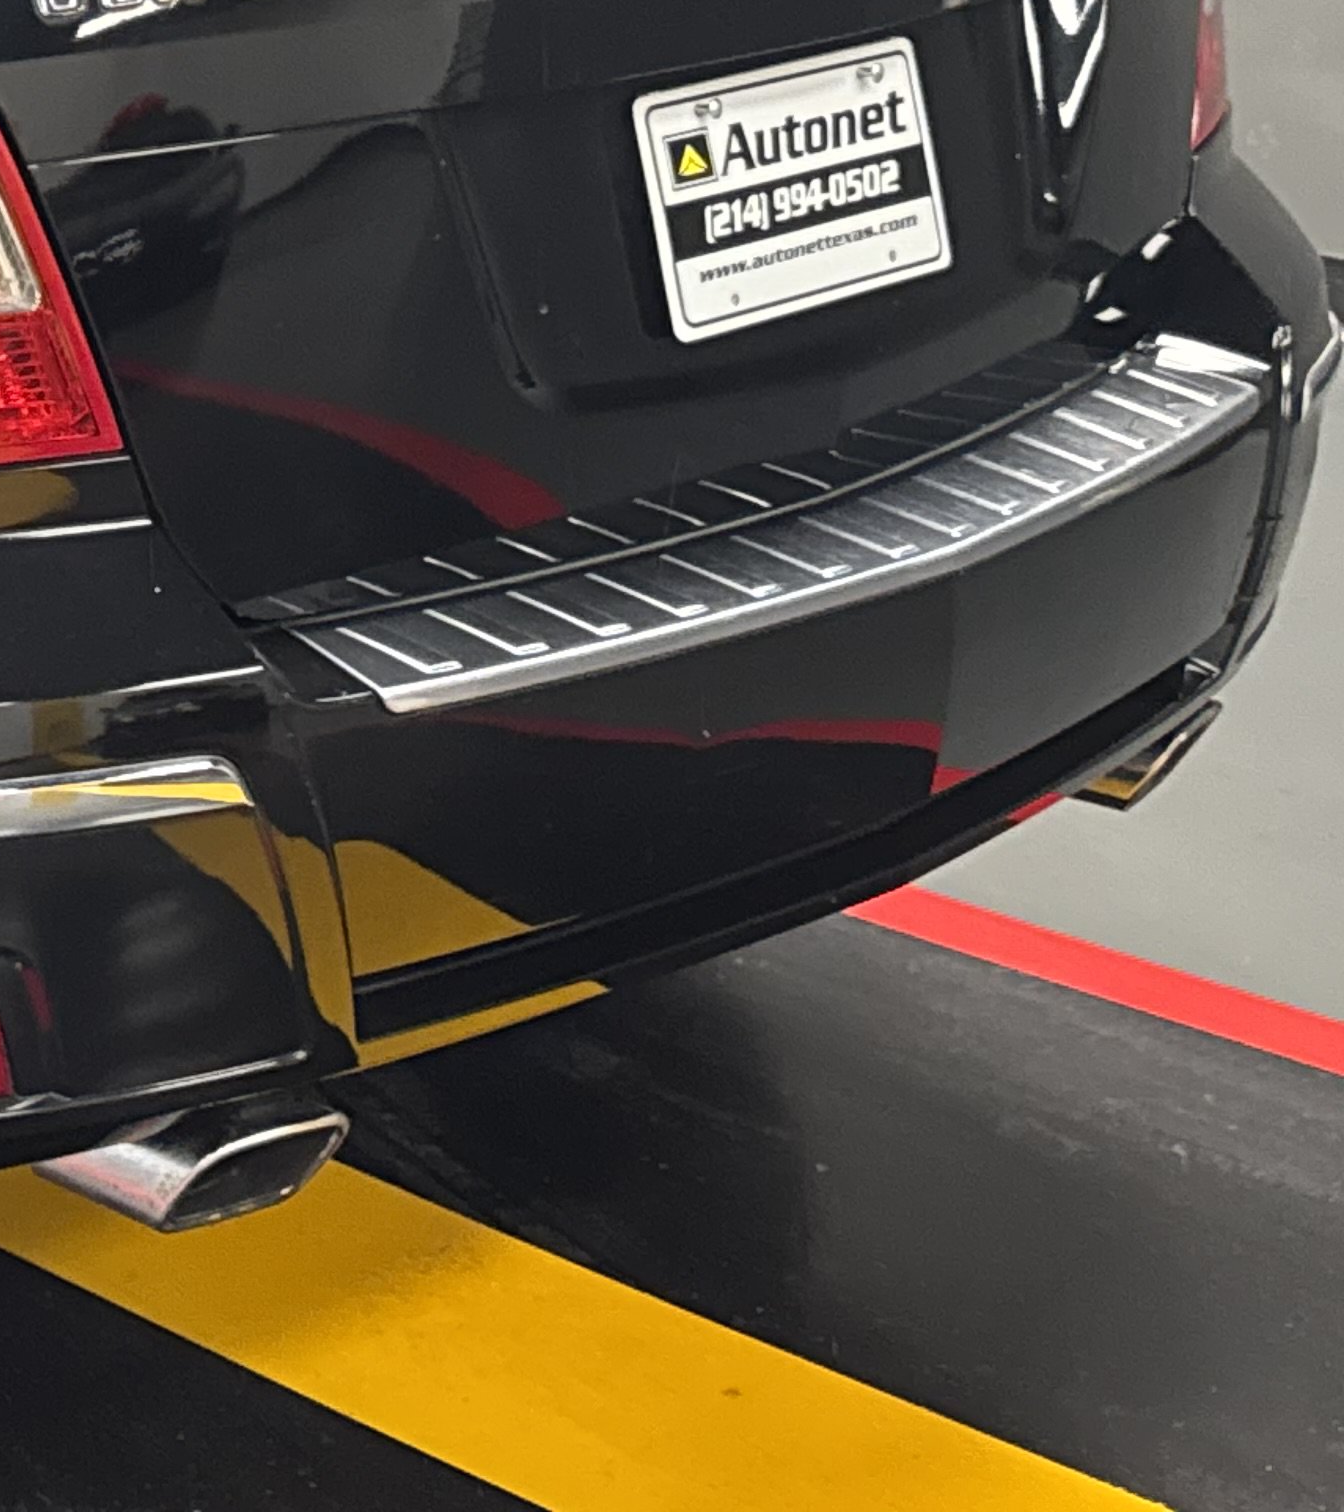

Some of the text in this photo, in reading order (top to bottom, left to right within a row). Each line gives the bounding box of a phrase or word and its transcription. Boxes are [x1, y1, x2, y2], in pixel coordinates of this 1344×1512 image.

[721, 91, 907, 176] Autonet
[703, 159, 901, 244] (214) 994-0502
[699, 213, 919, 283] www.autonettexas.com
